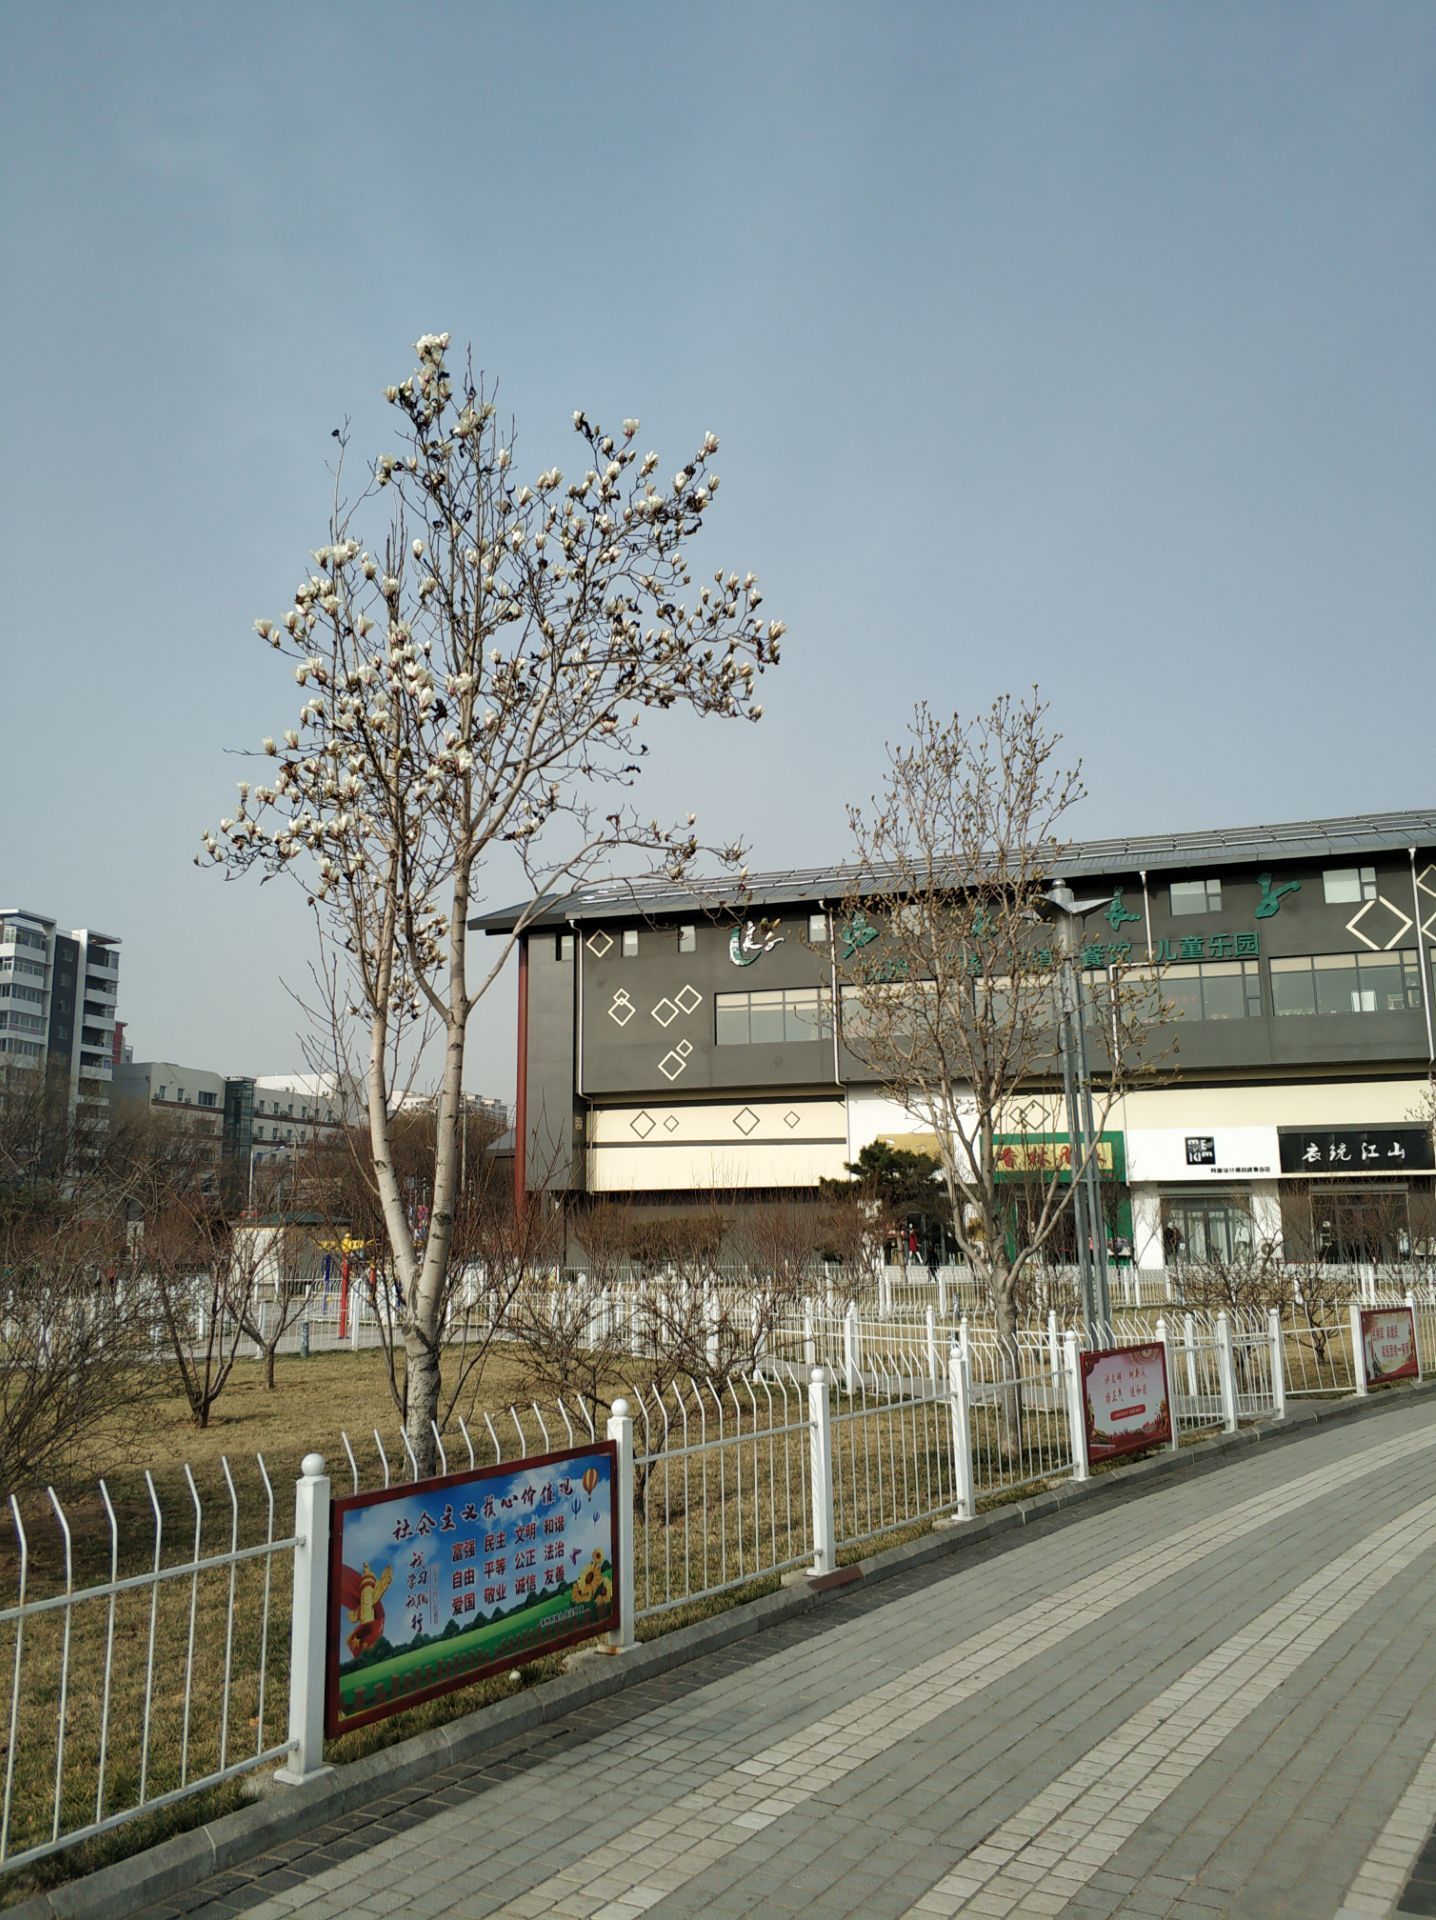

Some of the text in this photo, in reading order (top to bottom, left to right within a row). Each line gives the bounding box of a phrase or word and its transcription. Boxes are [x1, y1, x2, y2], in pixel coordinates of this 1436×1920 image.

[1156, 931, 1261, 963] 儿童乐园
[392, 1477, 575, 1541] 社会主义核心价值观
[452, 1515, 565, 1562] 富强 民主 文明 和谐
[452, 1540, 565, 1590] 自由 平等 公正 法治
[452, 1564, 565, 1616] 爱国 敬业 诚信 友善
